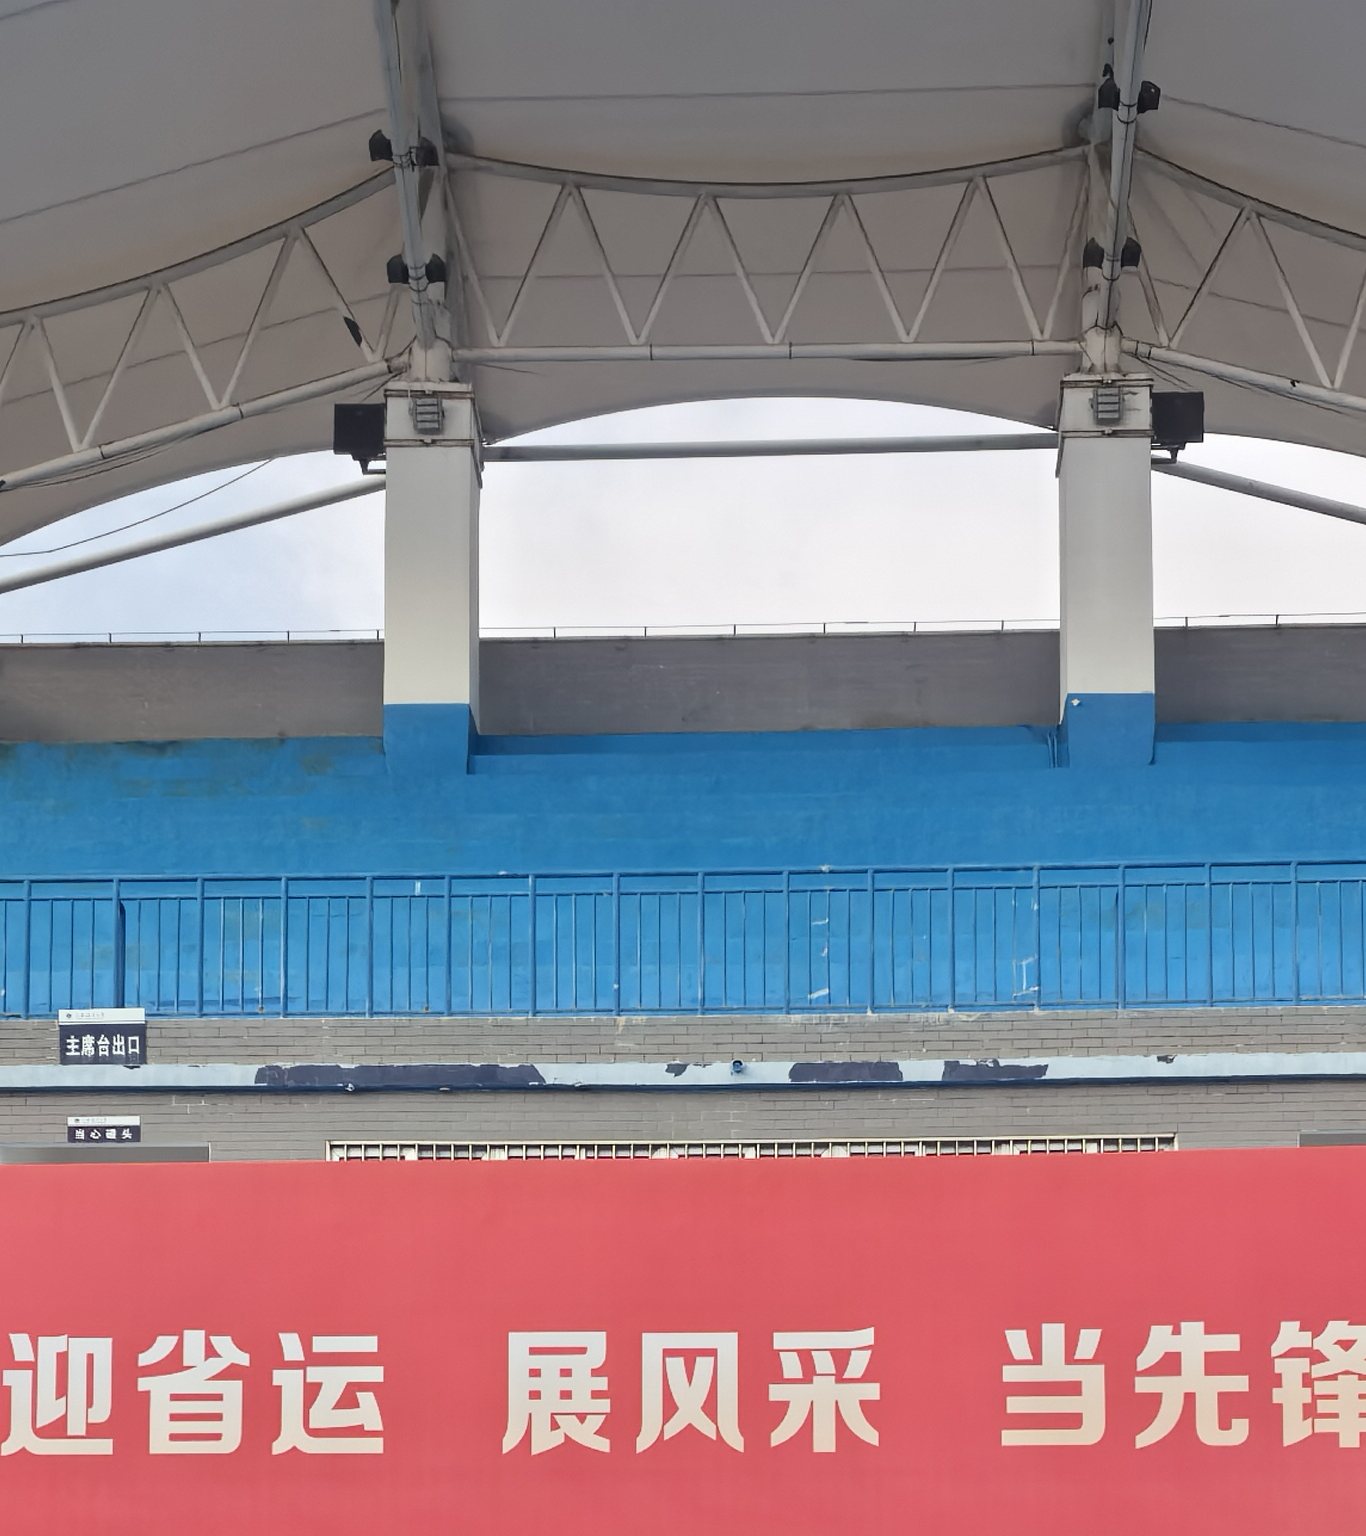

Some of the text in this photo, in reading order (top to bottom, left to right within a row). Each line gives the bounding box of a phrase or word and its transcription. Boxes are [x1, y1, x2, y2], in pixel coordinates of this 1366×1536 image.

[66, 1034, 140, 1057] 主席台出口
[502, 1326, 881, 1456] 展风采
